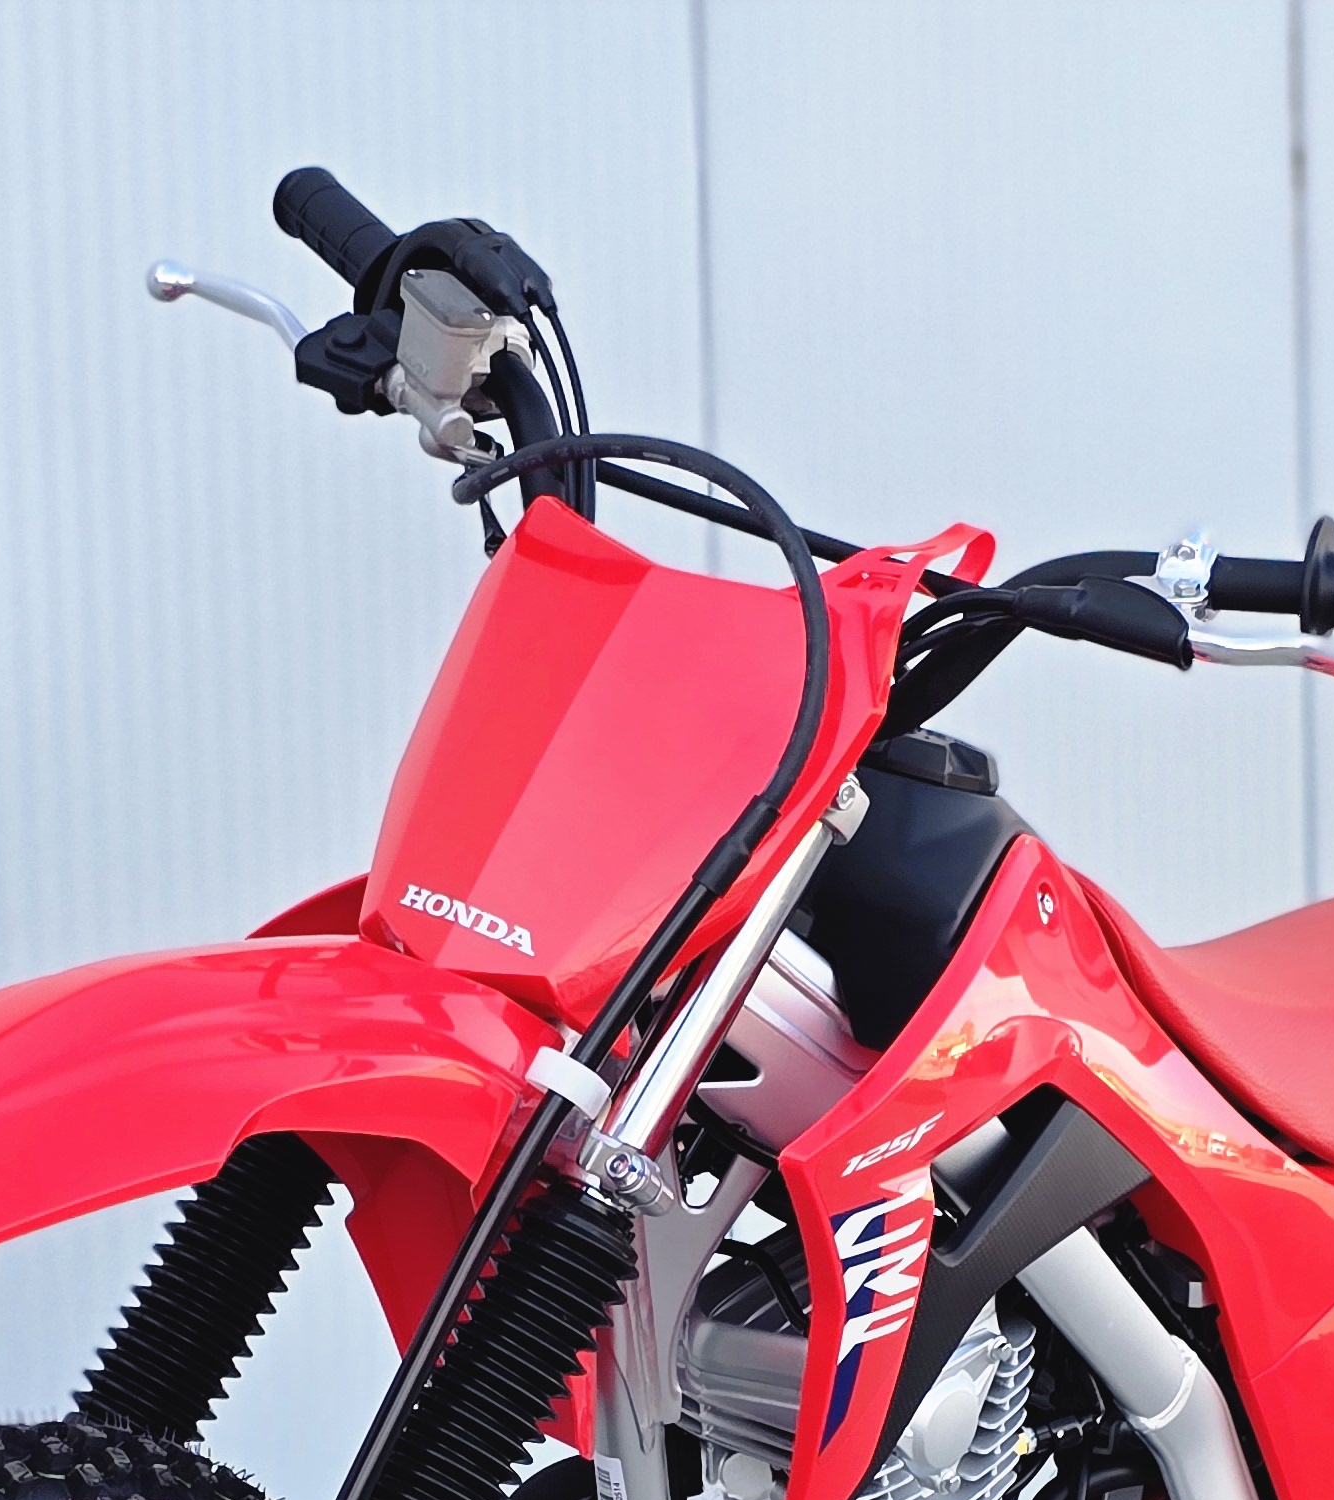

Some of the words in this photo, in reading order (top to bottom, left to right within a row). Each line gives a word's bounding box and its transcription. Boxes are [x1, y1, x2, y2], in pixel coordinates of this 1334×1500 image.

[399, 884, 535, 957] HONDA
[840, 1110, 945, 1178] 125F
[833, 1178, 930, 1366] CRF
